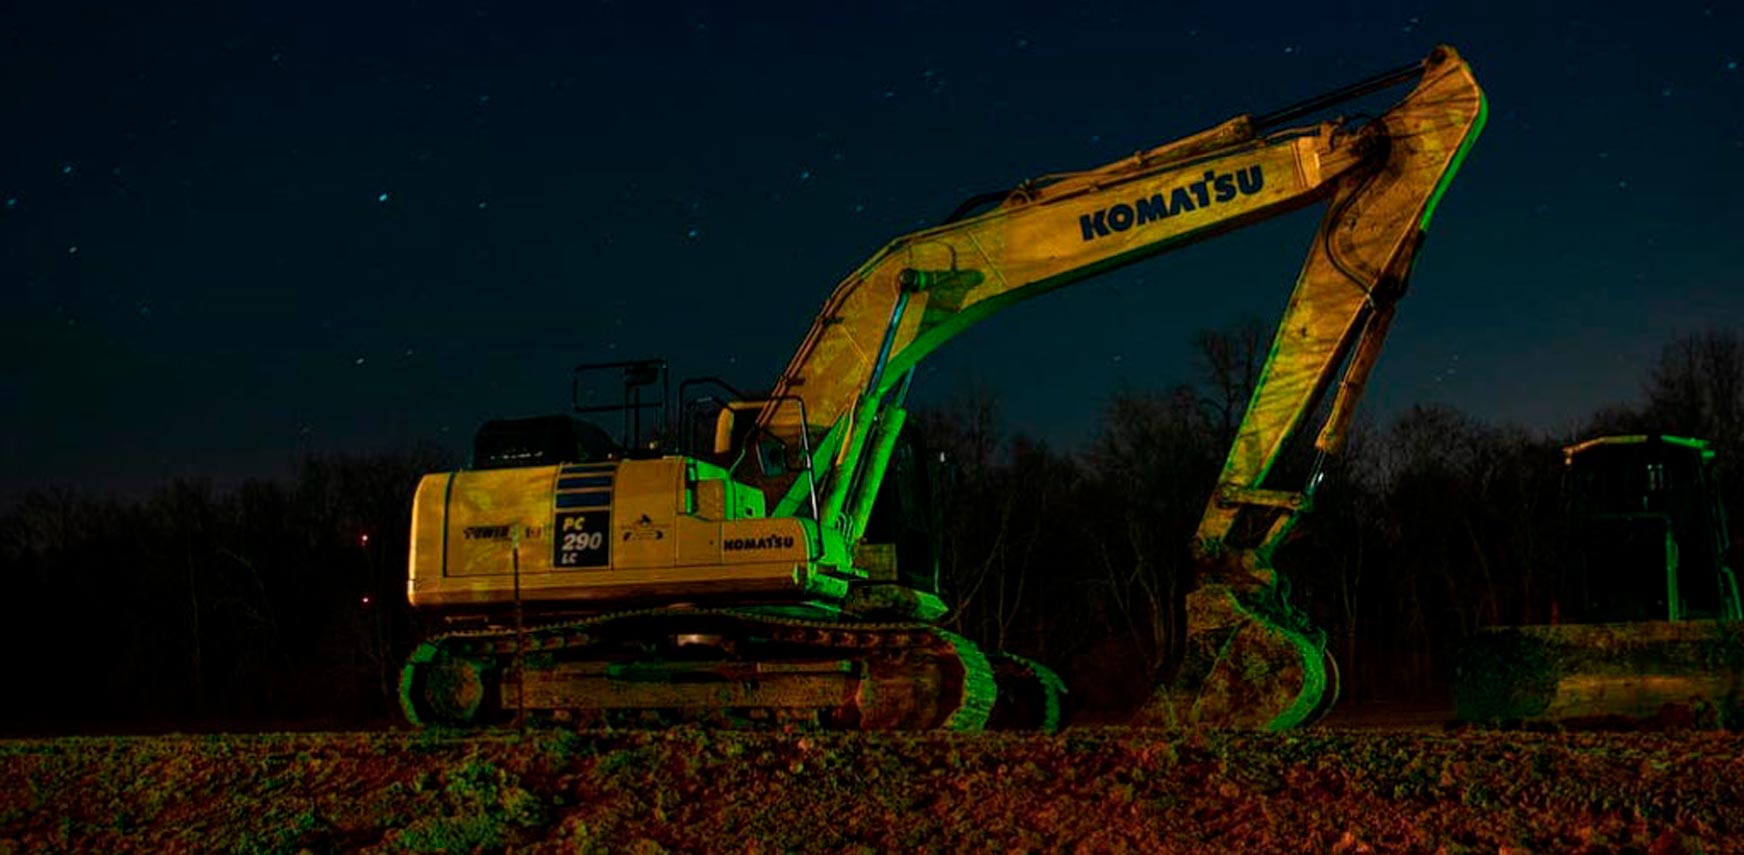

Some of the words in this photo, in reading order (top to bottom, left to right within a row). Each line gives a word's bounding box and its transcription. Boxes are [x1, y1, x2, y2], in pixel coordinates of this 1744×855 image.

[1080, 165, 1264, 240] KOMATSU
[562, 516, 586, 531] PC
[561, 531, 603, 551] 290
[724, 534, 793, 549] KOMATSU
[561, 551, 580, 564] LC
